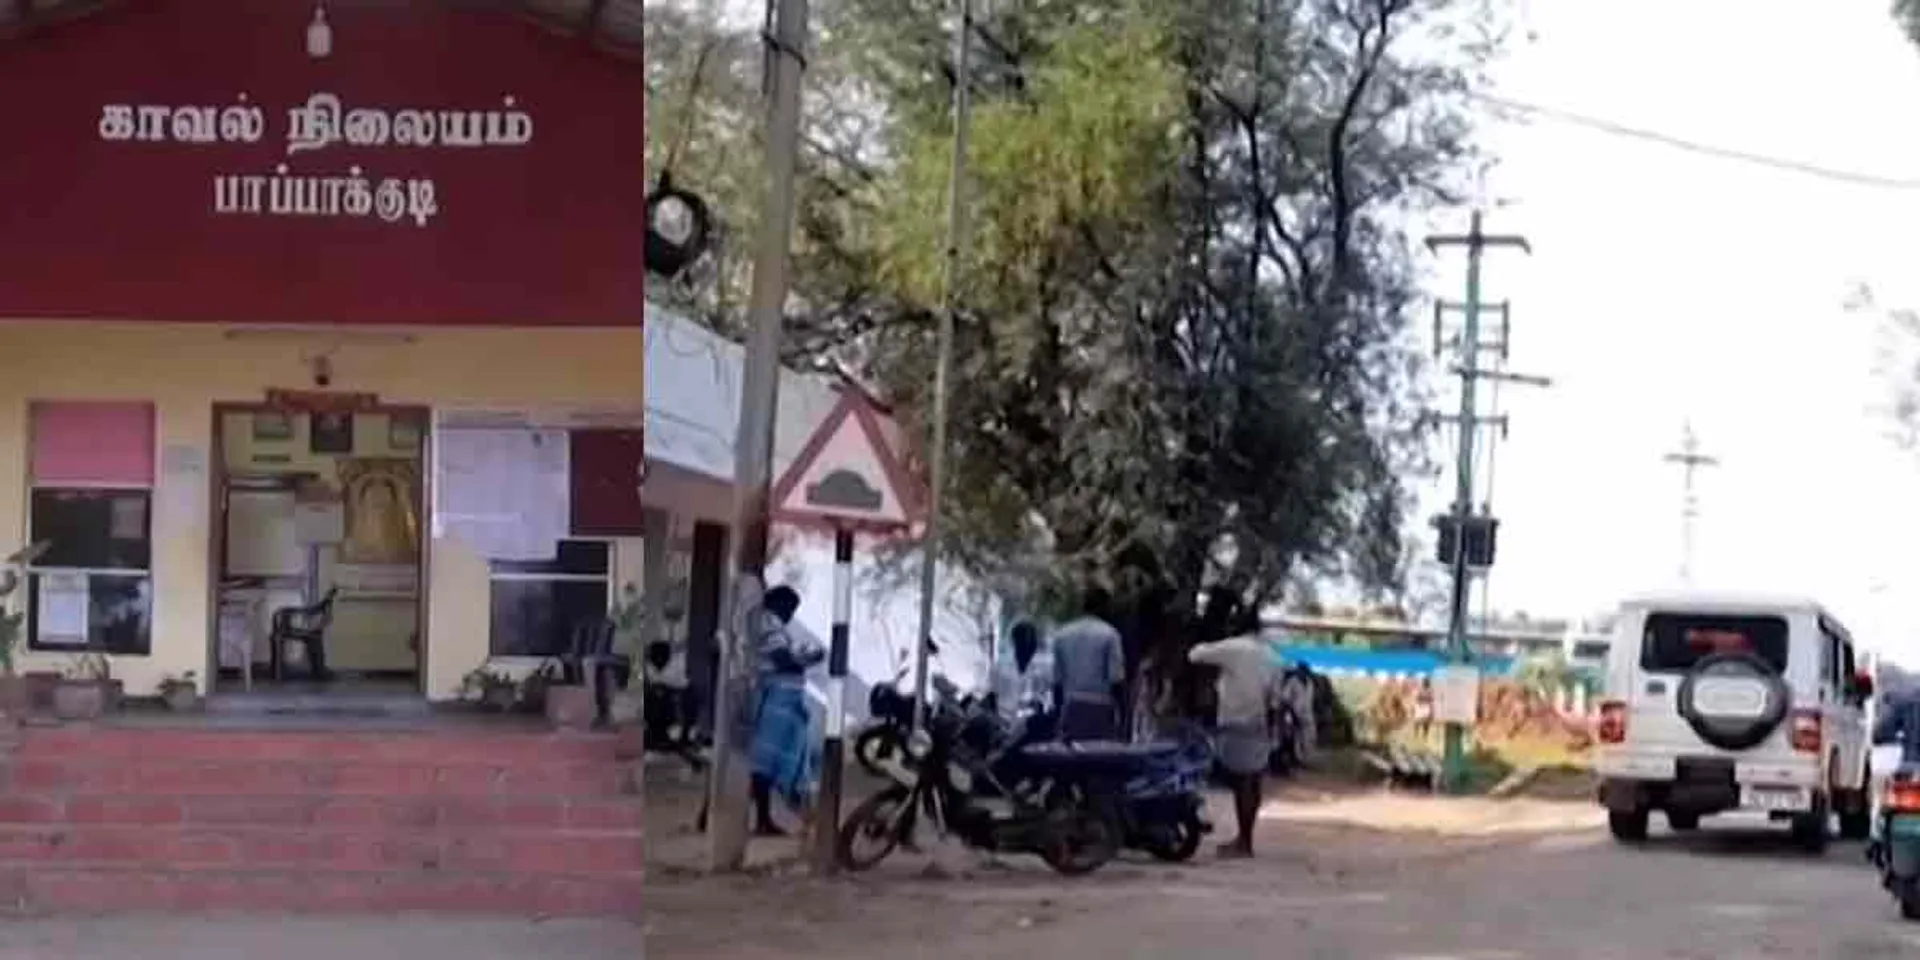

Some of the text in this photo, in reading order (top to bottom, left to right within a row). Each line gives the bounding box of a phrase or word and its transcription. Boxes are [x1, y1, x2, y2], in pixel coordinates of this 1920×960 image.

[99, 93, 533, 155] காவல் நிலையம்
[214, 163, 437, 226] பாப்பாக்குடி
